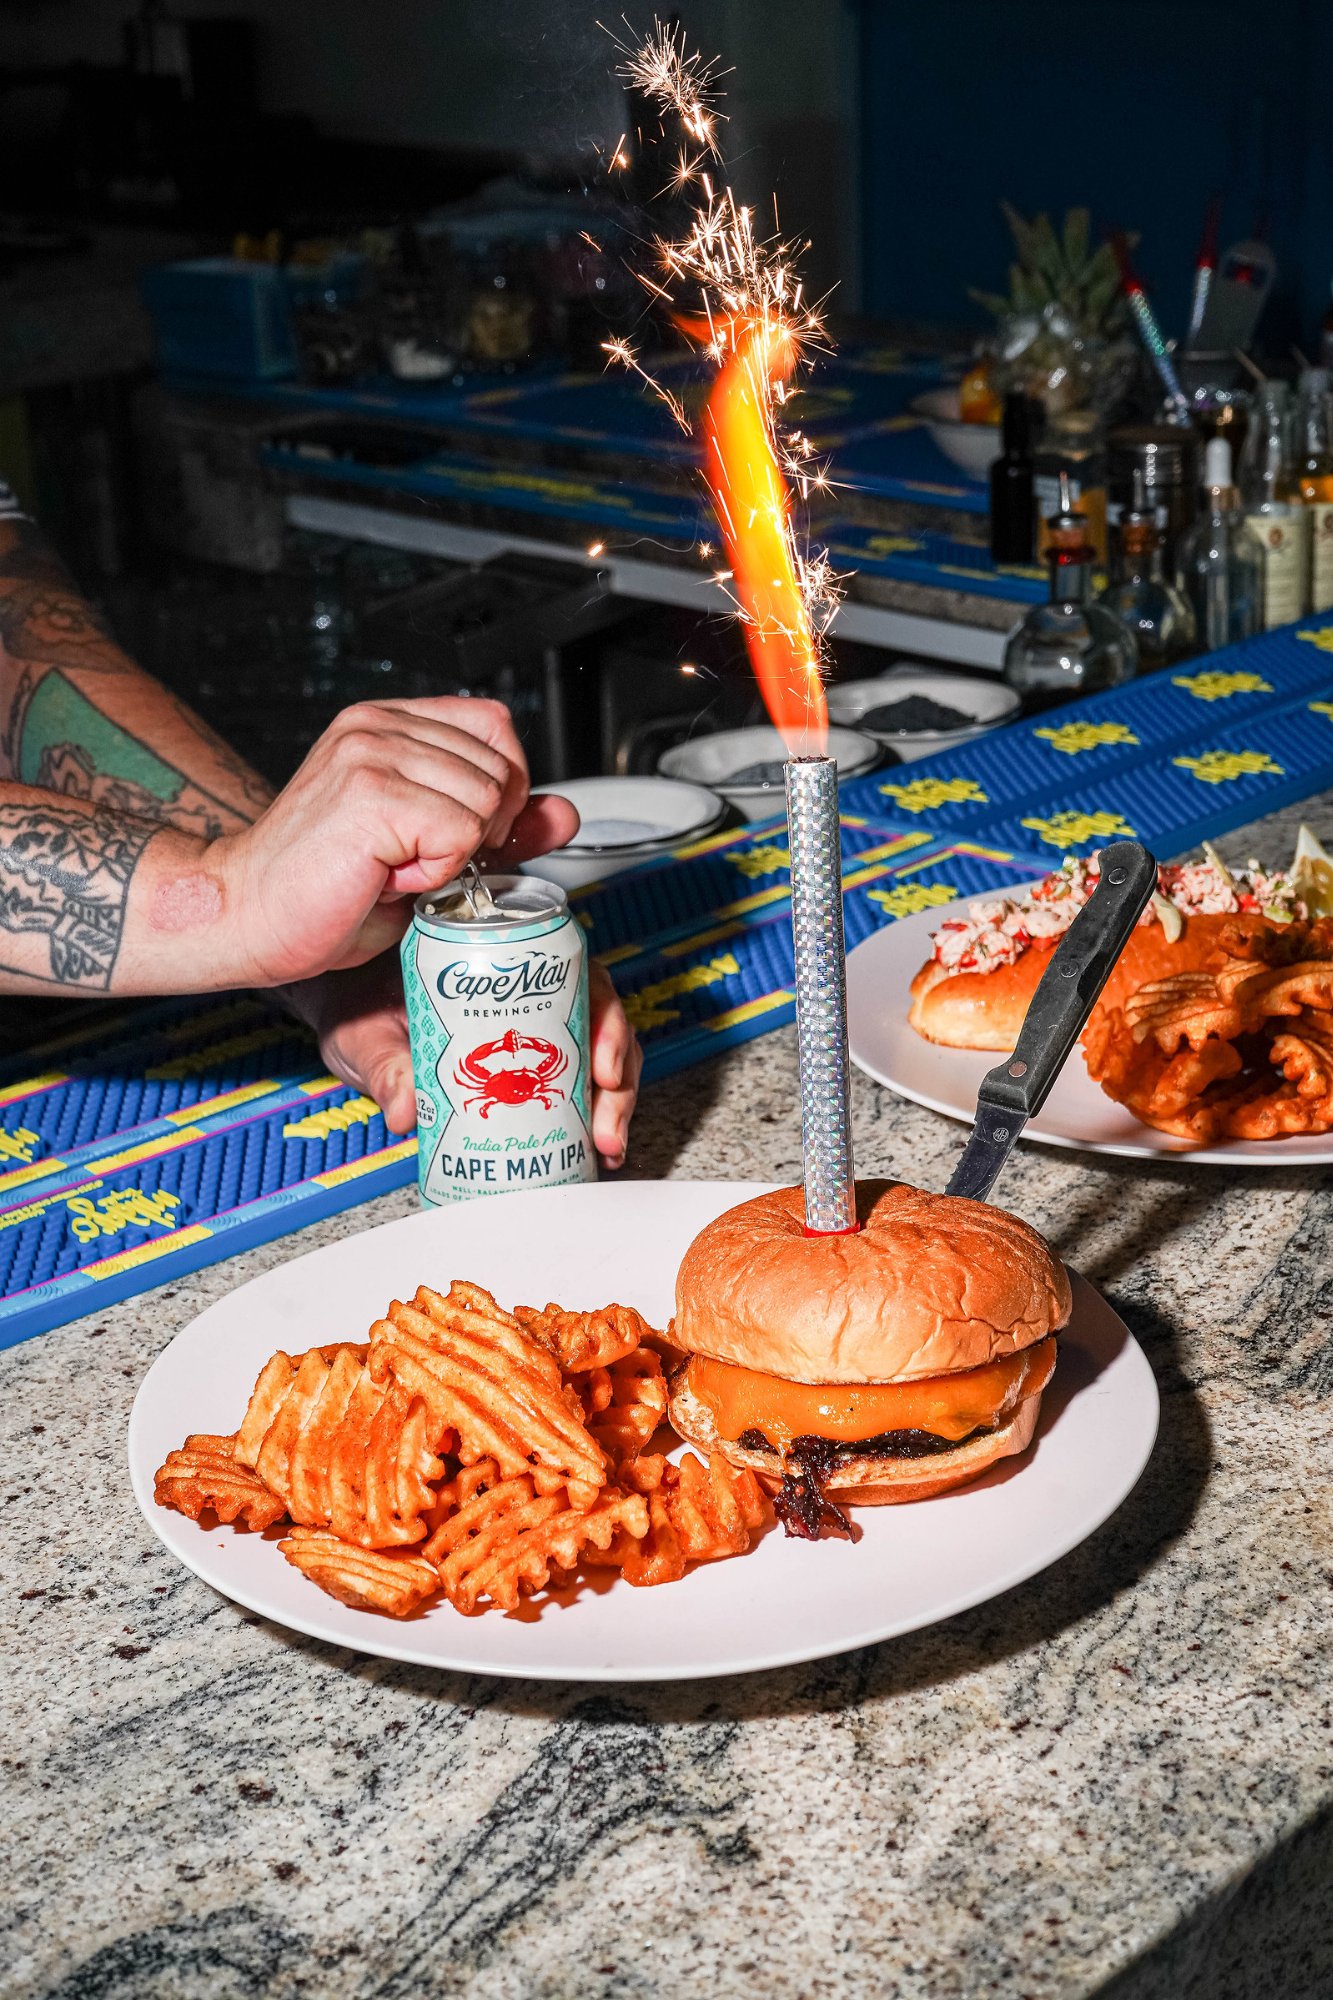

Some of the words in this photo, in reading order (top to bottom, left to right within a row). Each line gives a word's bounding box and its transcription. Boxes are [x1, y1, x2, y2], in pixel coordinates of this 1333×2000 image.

[816, 936, 826, 957] MADE
[436, 960, 511, 1002] Cape
[490, 958, 571, 1003] May
[817, 966, 828, 988] CHINA
[463, 1007, 530, 1018] BREWING
[536, 1000, 552, 1011] CO
[462, 1136, 503, 1152] India
[504, 1134, 540, 1152] Pale
[541, 1127, 568, 1147] Ale
[441, 1153, 497, 1182] CAPE
[506, 1151, 553, 1182] MAY
[560, 1138, 586, 1170] IPA
